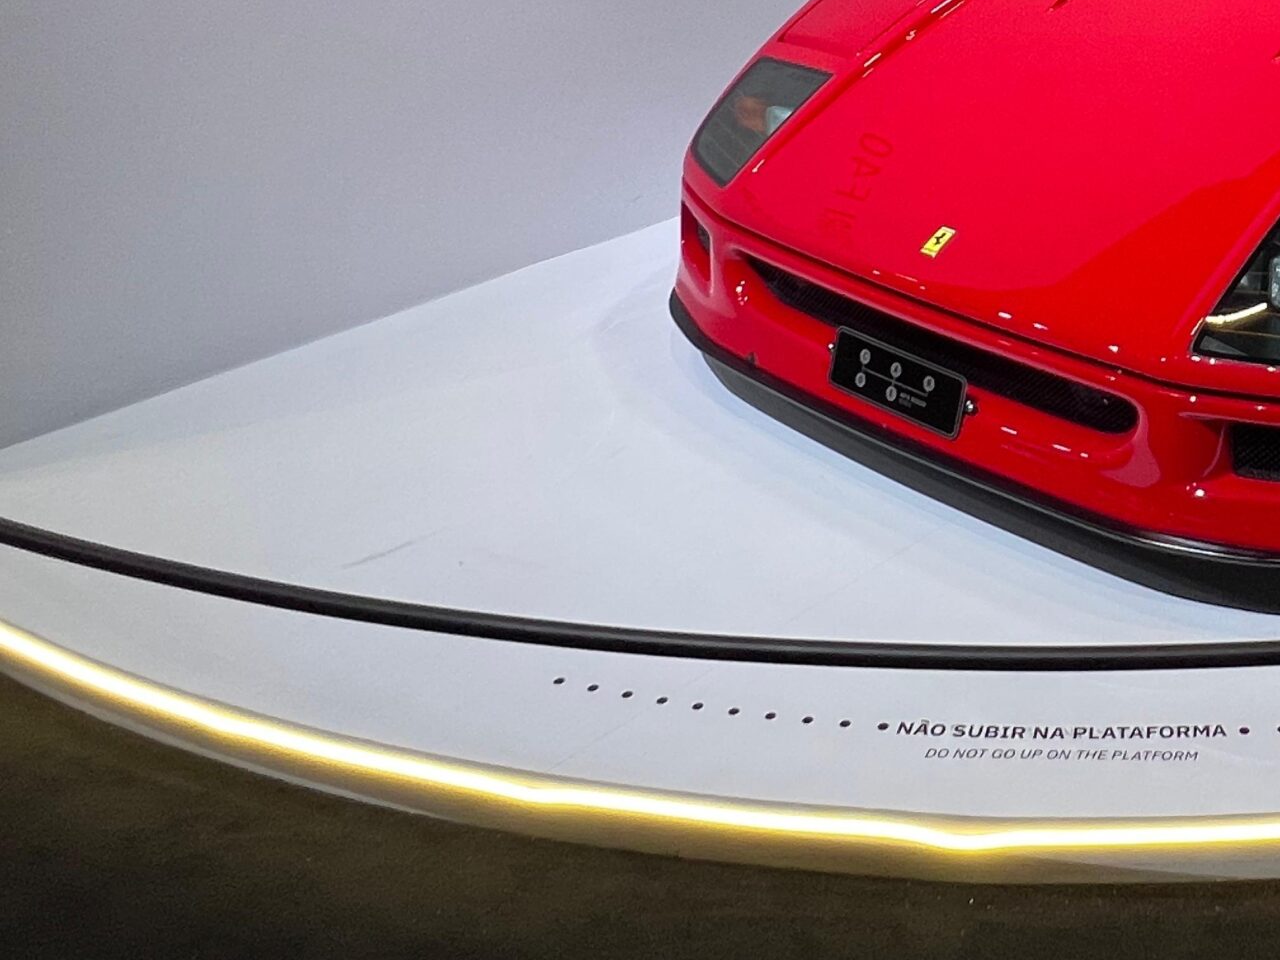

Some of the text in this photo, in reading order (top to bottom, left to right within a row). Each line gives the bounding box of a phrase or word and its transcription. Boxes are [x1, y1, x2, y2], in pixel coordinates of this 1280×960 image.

[896, 719, 1227, 739] NÃO SUBIR NA PLATAFORMA
[925, 748, 1199, 761] DO NOT GO UP ON THE PLATFORM
